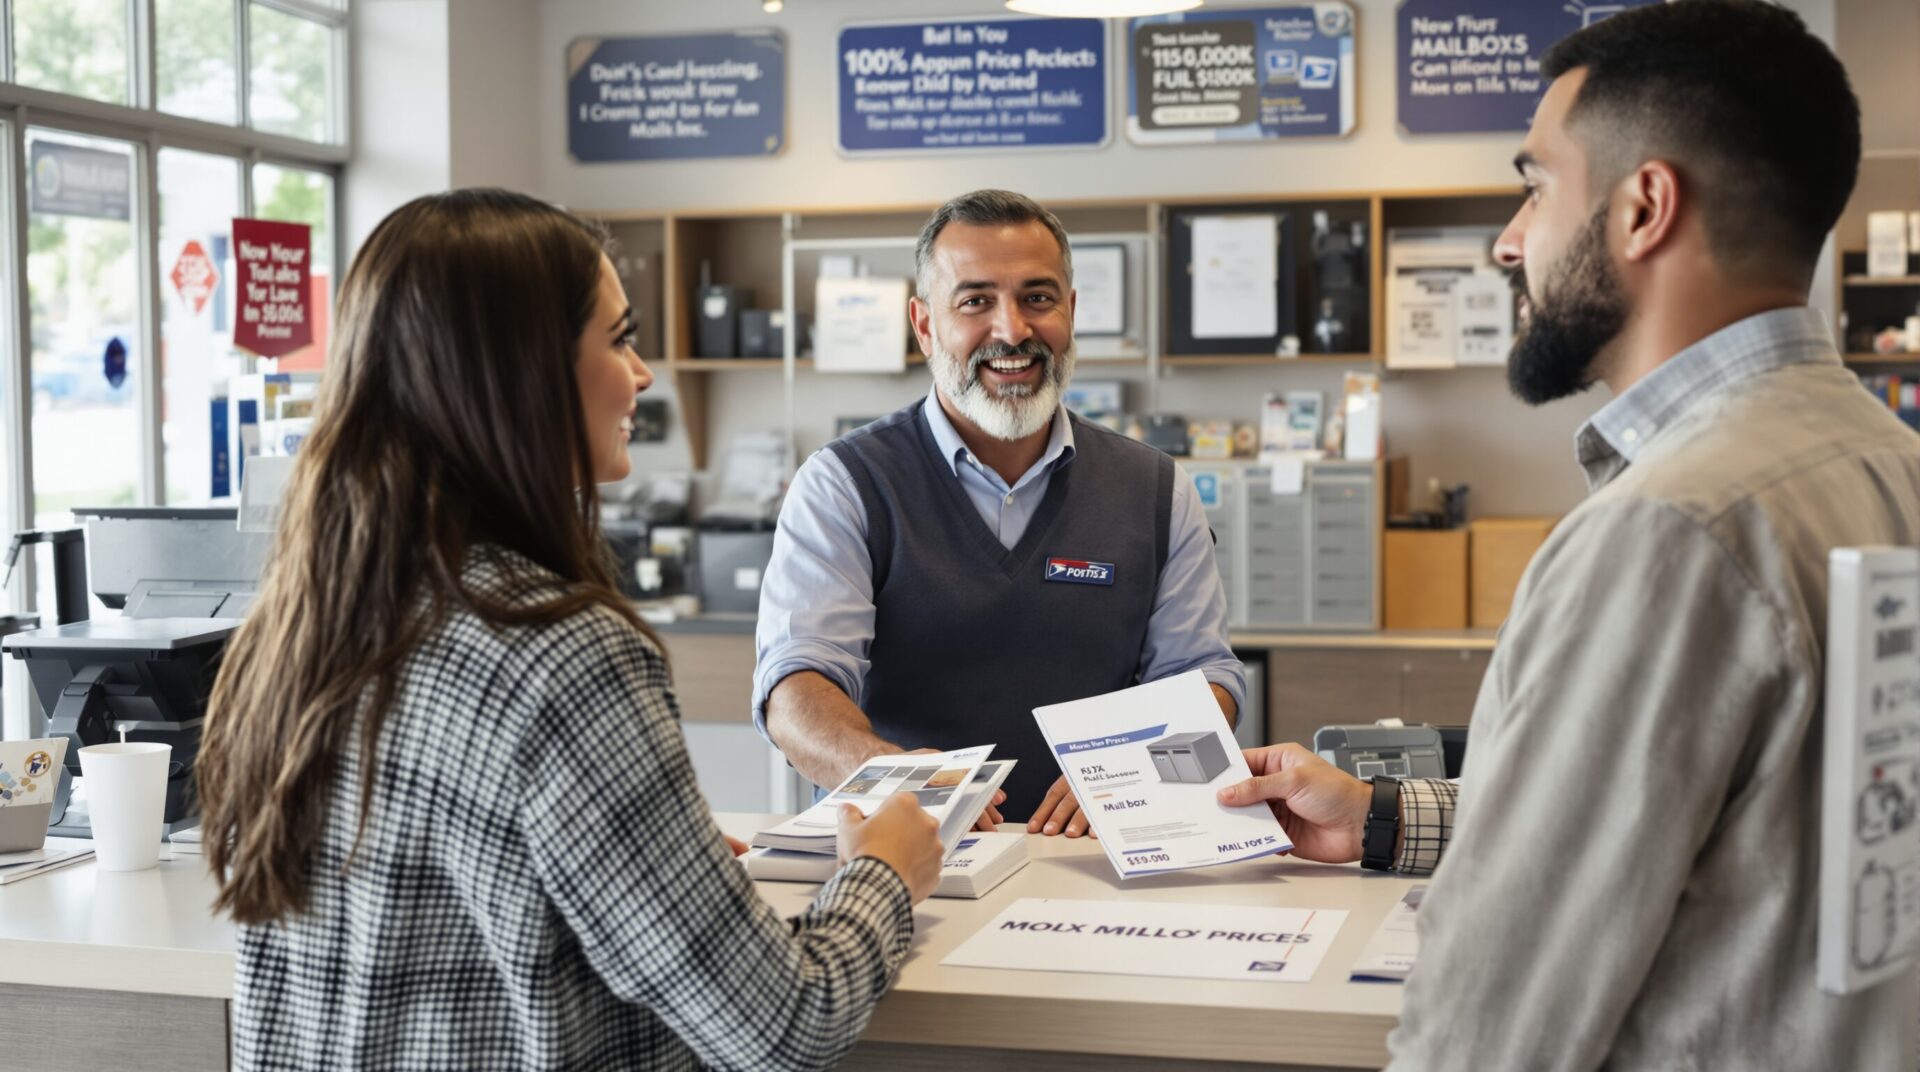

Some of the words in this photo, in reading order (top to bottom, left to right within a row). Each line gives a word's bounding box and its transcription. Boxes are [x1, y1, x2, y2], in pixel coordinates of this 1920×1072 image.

[976, 26, 1008, 43] You
[1411, 34, 1528, 57] MAILBOXS
[844, 48, 908, 75] 100%
[976, 50, 1022, 69] Price
[1126, 798, 1148, 808] box
[1217, 842, 1245, 854] MAIL
[1000, 920, 1088, 935] MOLX
[1206, 930, 1313, 944] PRICES
